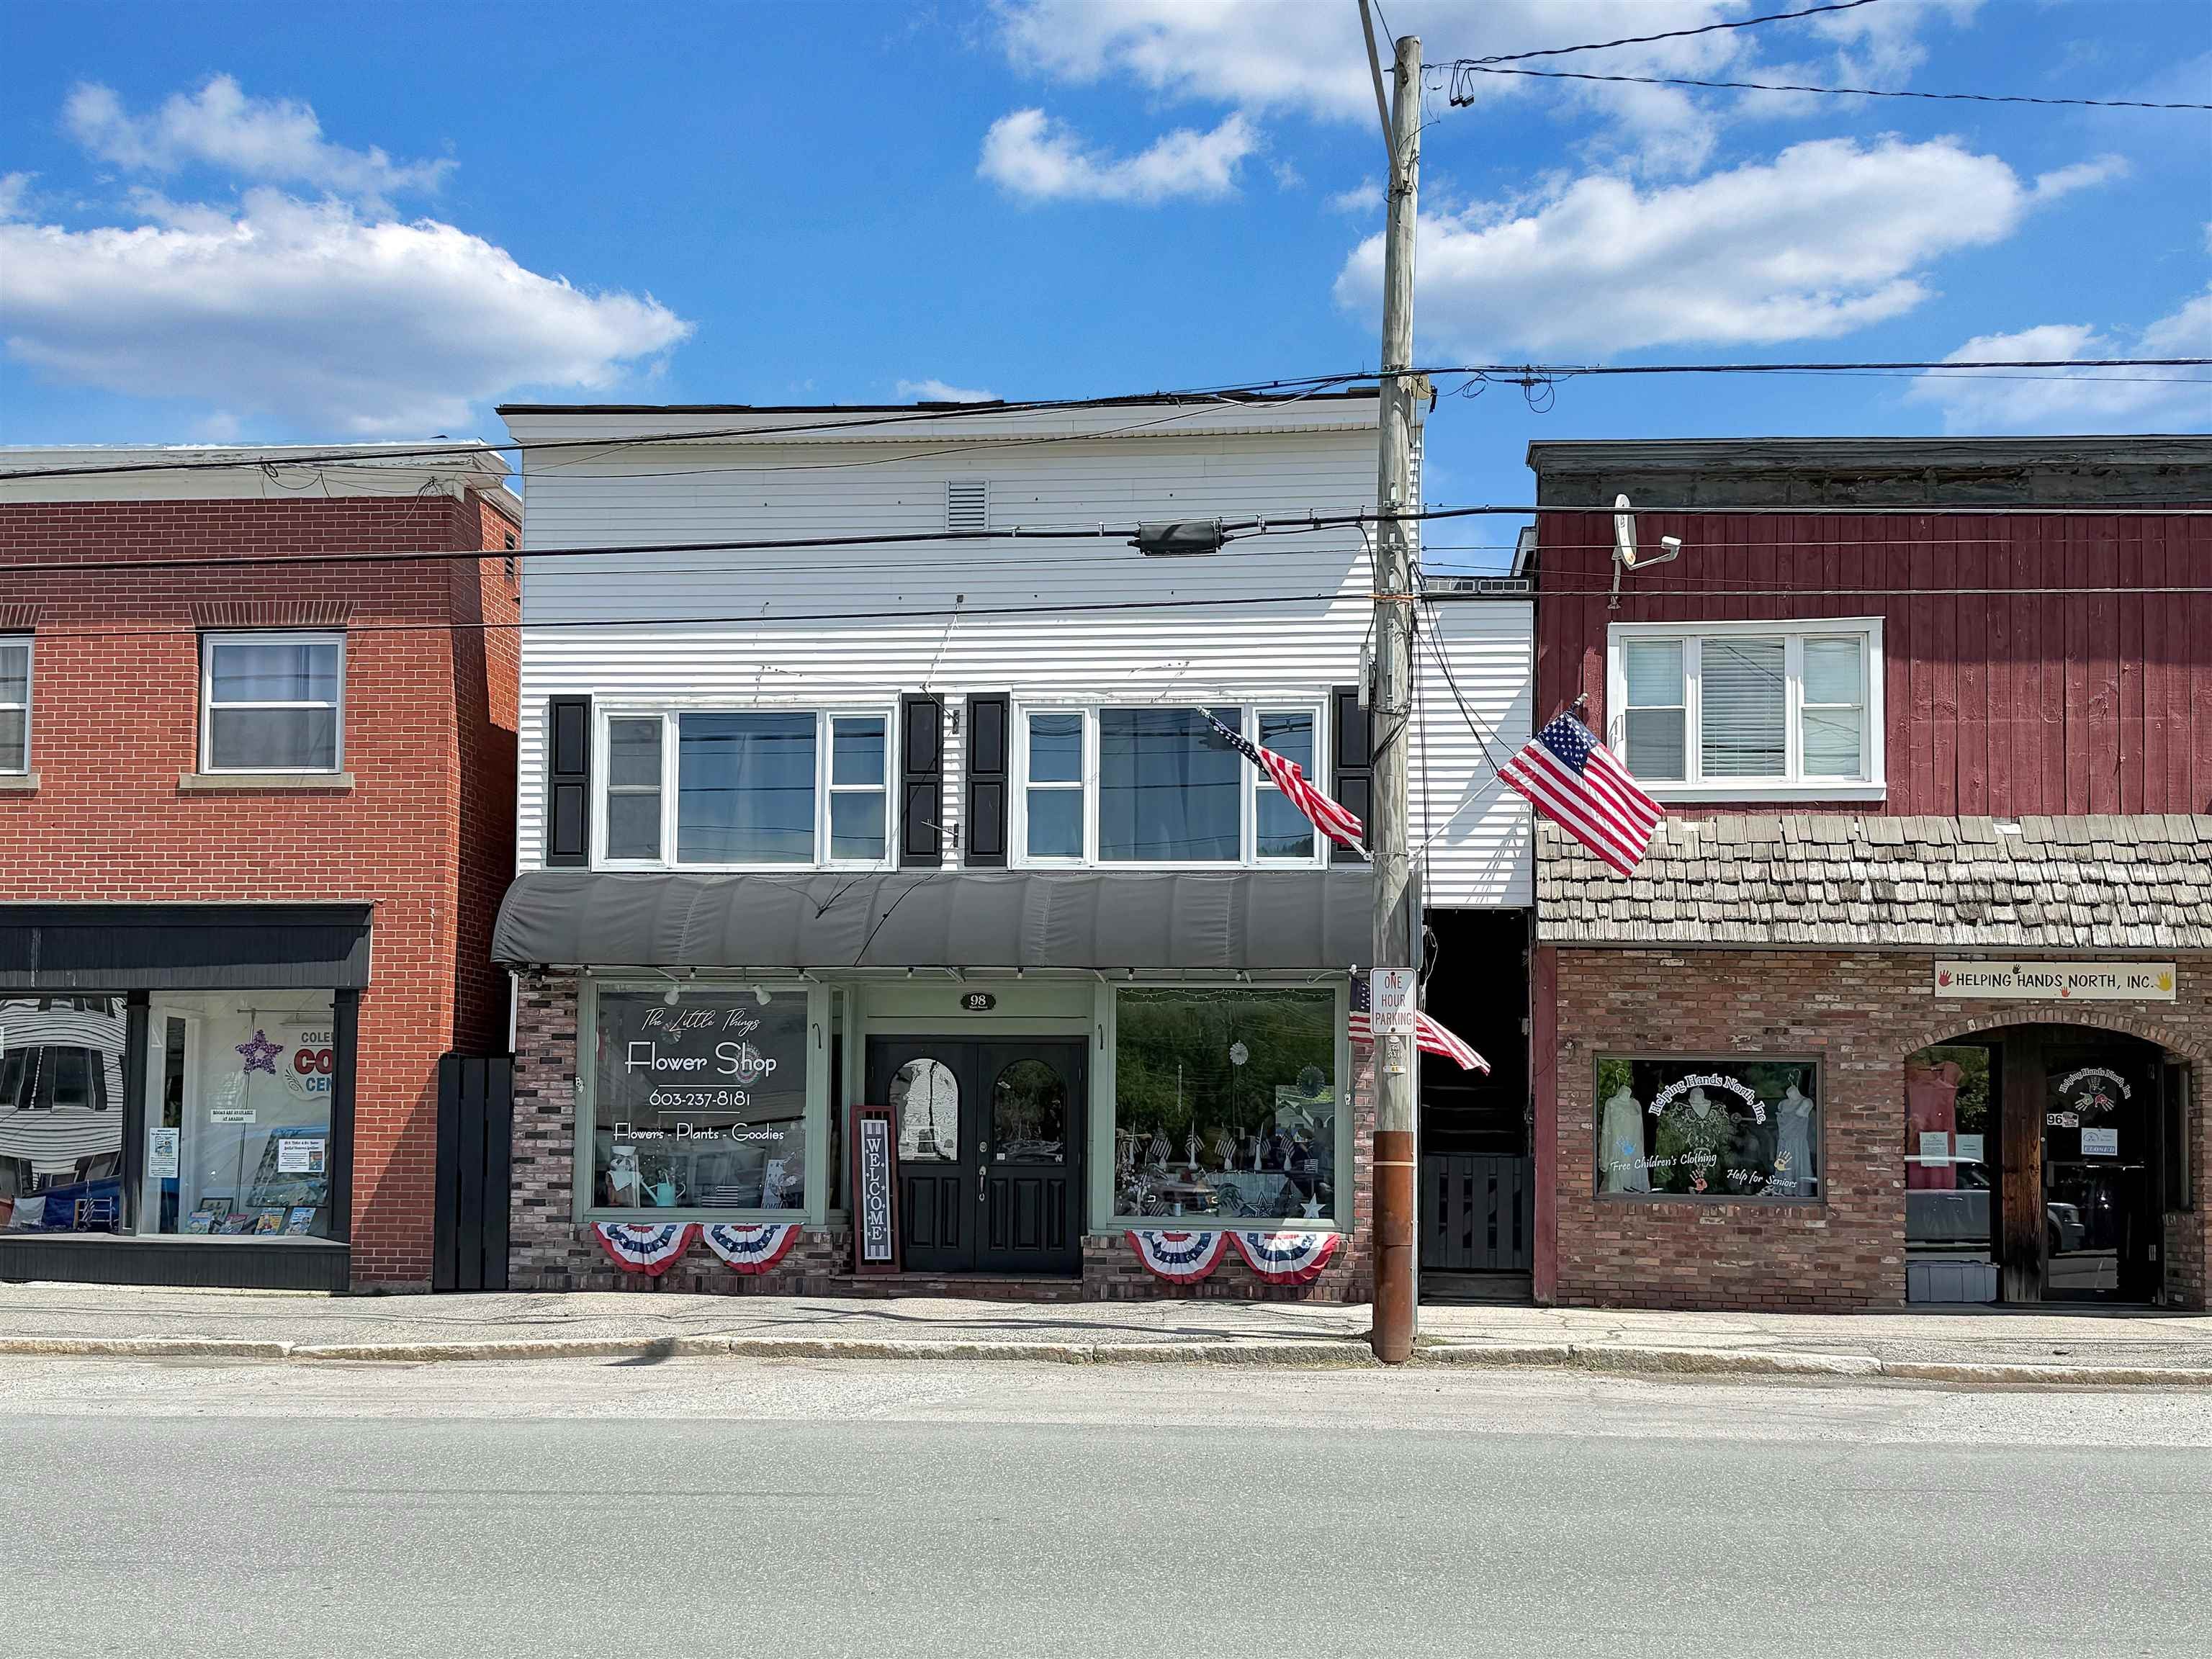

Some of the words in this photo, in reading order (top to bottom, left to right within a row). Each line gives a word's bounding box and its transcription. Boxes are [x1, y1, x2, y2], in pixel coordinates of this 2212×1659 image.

[1385, 976, 1403, 989] ONE
[1956, 974, 2011, 987] HELPING
[2017, 974, 2063, 987] HANDS
[2068, 974, 2121, 990] NORTH,
[2127, 975, 2154, 989] INC.
[971, 994, 986, 1005] 98
[1382, 994, 1406, 1007] HOUR
[641, 1007, 667, 1031] The
[668, 1008, 716, 1032] Little
[721, 1007, 762, 1037] Things
[1375, 1012, 1412, 1025] PARKING
[624, 1041, 708, 1074] Flower
[715, 1041, 777, 1077] Shop
[649, 1089, 750, 1107] 603-237-8181
[1648, 1080, 1687, 1116] Helping
[1684, 1074, 1722, 1088] Hands
[1723, 1076, 1755, 1105] North,
[1752, 1101, 1766, 1125] Inc.
[2048, 1115, 2062, 1124] 96
[613, 1123, 663, 1141] Flowers
[677, 1123, 719, 1140] Plants
[732, 1123, 784, 1141] Goodies
[1610, 1161, 1630, 1172] Free
[1635, 1155, 1676, 1169] Children's
[1681, 1151, 1717, 1166] Clothing
[1727, 1169, 1748, 1185] Help
[1749, 1171, 1763, 1184] for
[1766, 1174, 1797, 1187] Seniors
[866, 1138, 884, 1240] WELCOME
